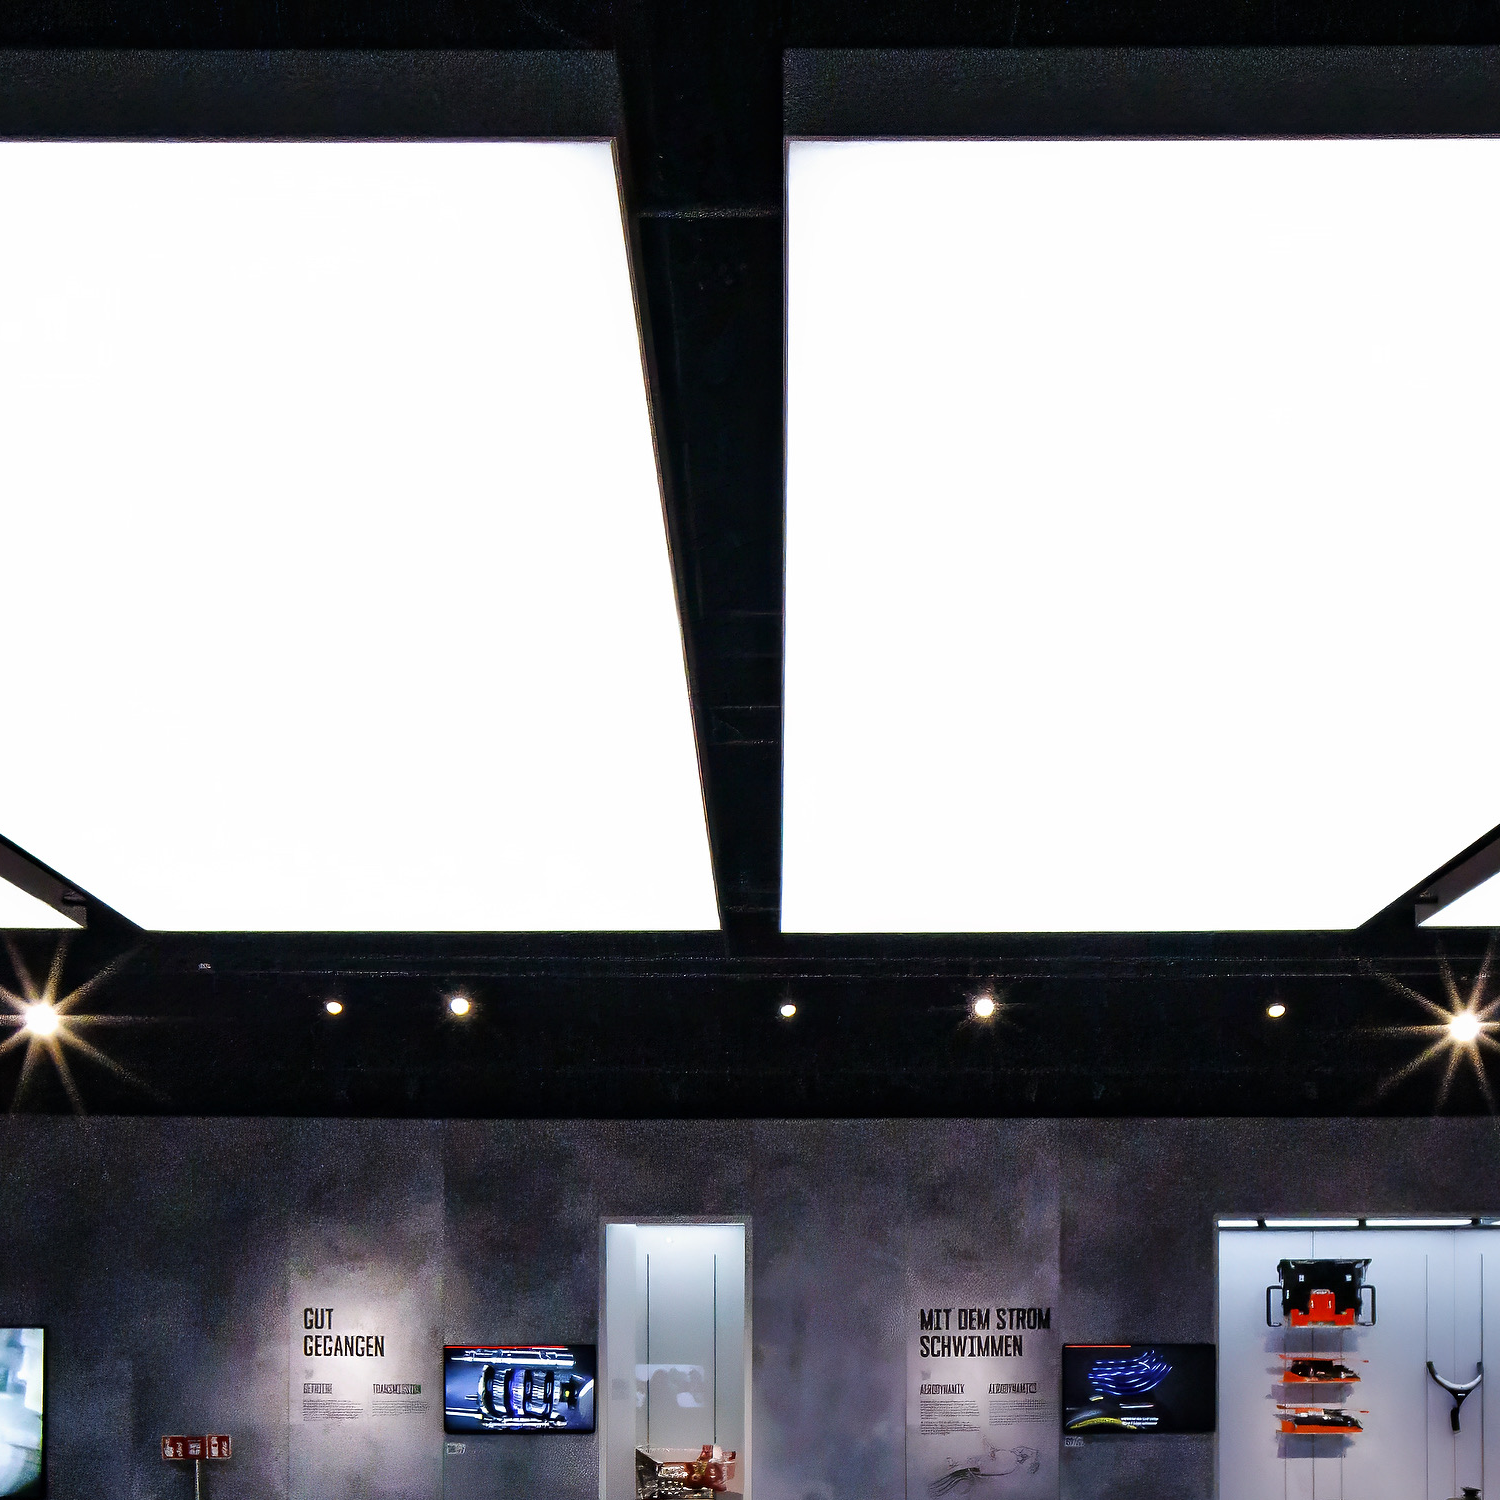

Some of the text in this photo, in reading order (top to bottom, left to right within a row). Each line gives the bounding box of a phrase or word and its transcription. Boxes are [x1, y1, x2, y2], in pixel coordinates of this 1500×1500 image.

[303, 1307, 334, 1330] GUT
[920, 1306, 1051, 1330] MIT DEM STROM
[303, 1334, 385, 1357] GEGANGEN
[919, 1335, 1023, 1358] SCHWIMMEN
